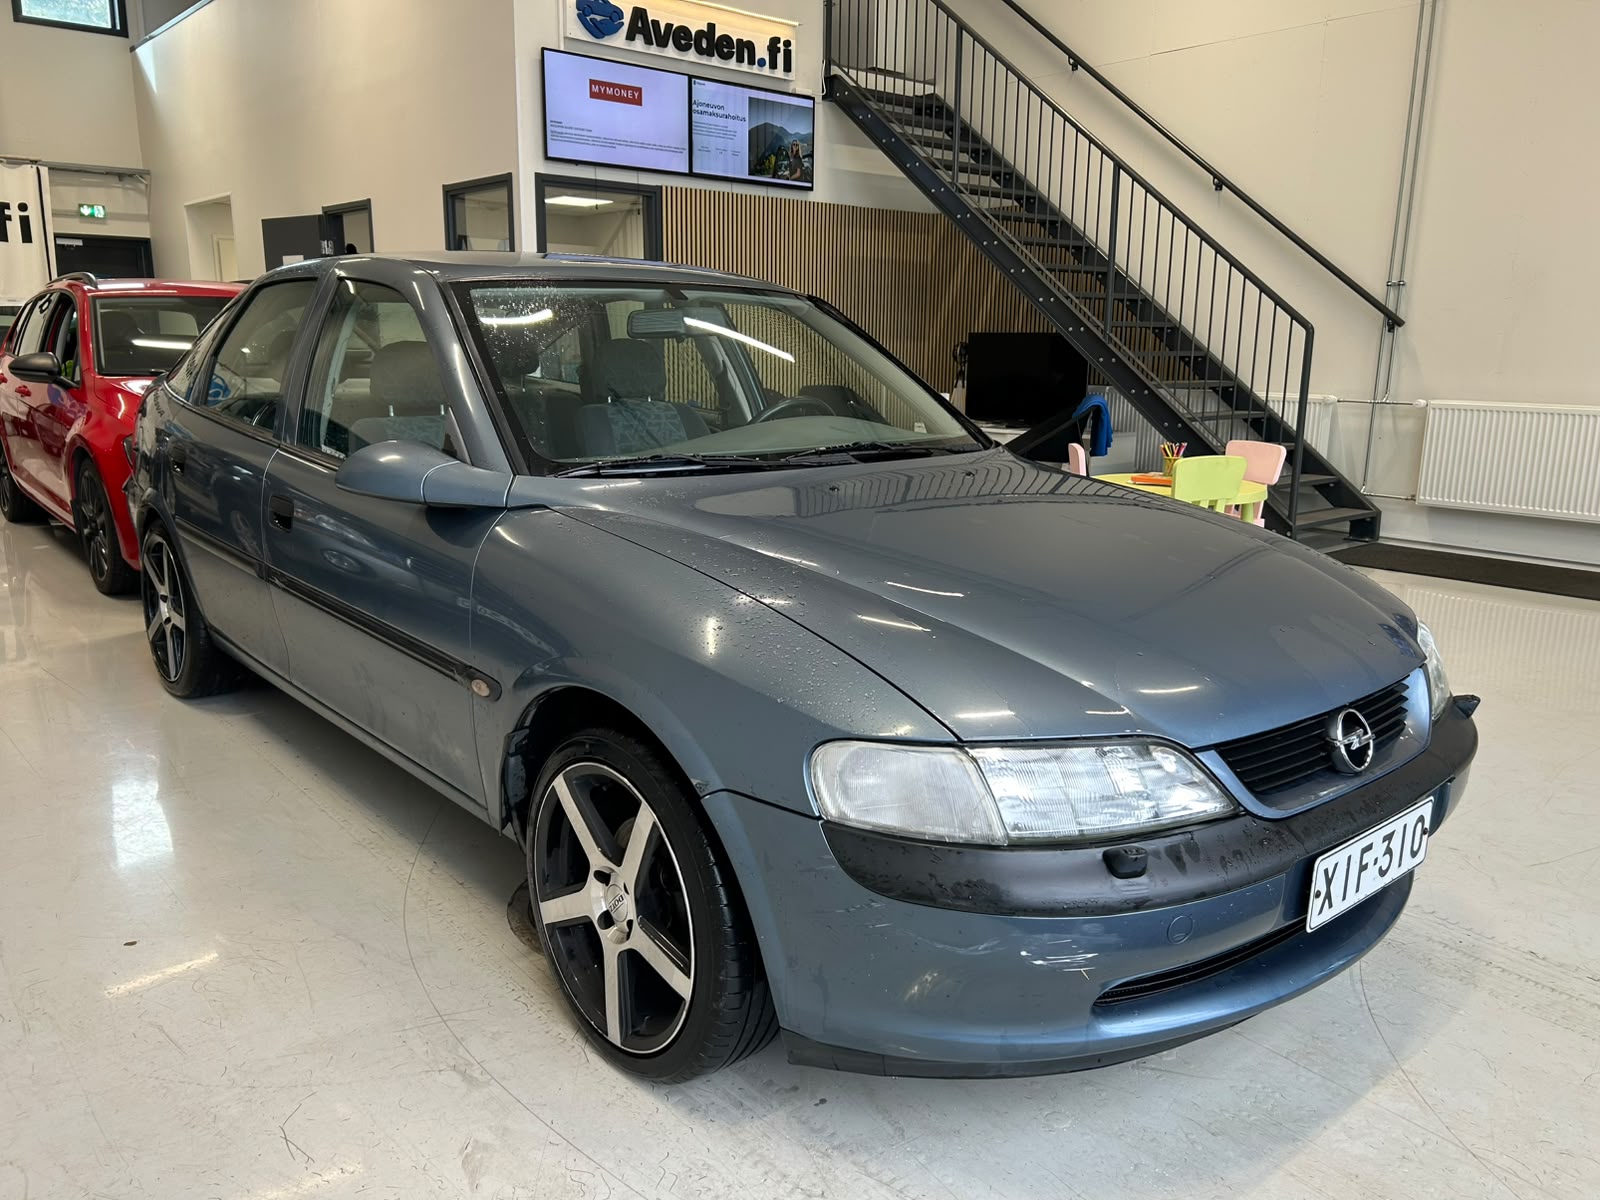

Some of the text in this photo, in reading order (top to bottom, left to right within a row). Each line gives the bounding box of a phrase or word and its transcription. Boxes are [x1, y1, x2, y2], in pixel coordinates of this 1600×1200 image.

[625, 6, 792, 73] Aveden.fi
[591, 84, 640, 99] MYMONEY
[692, 99, 725, 111] Ajoneuvon
[692, 108, 747, 122] osamaksurahoitus
[1317, 814, 1426, 916] XIF-310
[609, 895, 624, 912] DOTZ
